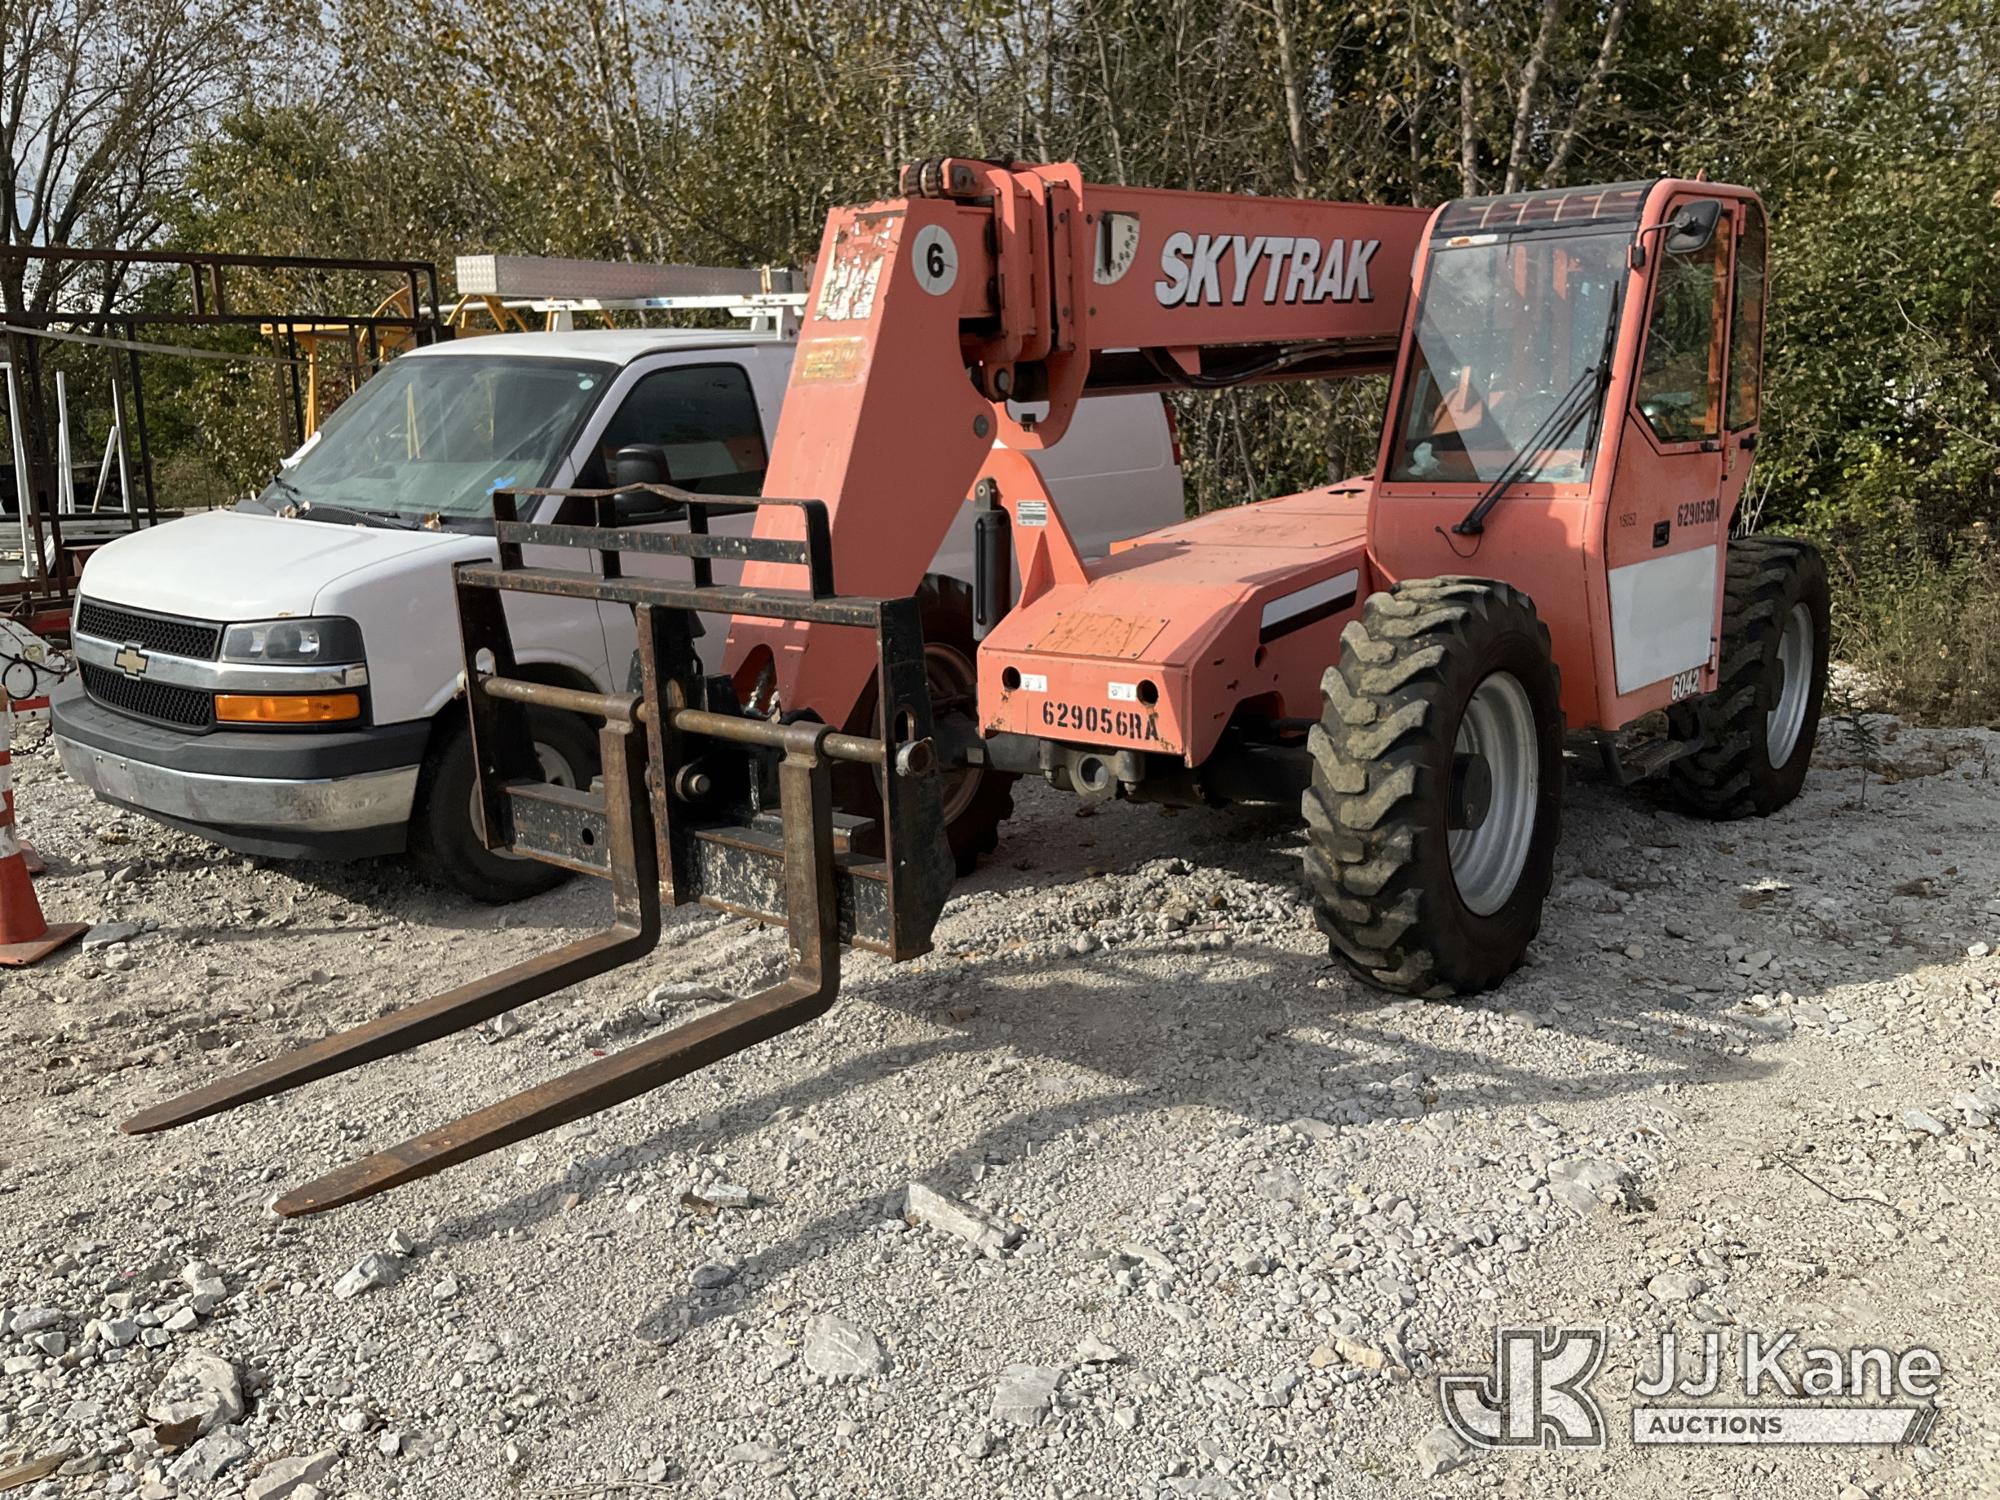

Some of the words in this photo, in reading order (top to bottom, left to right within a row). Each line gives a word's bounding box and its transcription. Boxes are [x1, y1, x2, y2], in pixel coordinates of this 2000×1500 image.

[927, 243, 944, 278] 6
[1154, 231, 1381, 308] SKYTRAK
[1677, 499, 1720, 527] 629056RA
[1671, 669, 1700, 701] 6042
[1042, 700, 1159, 740] 629056RA
